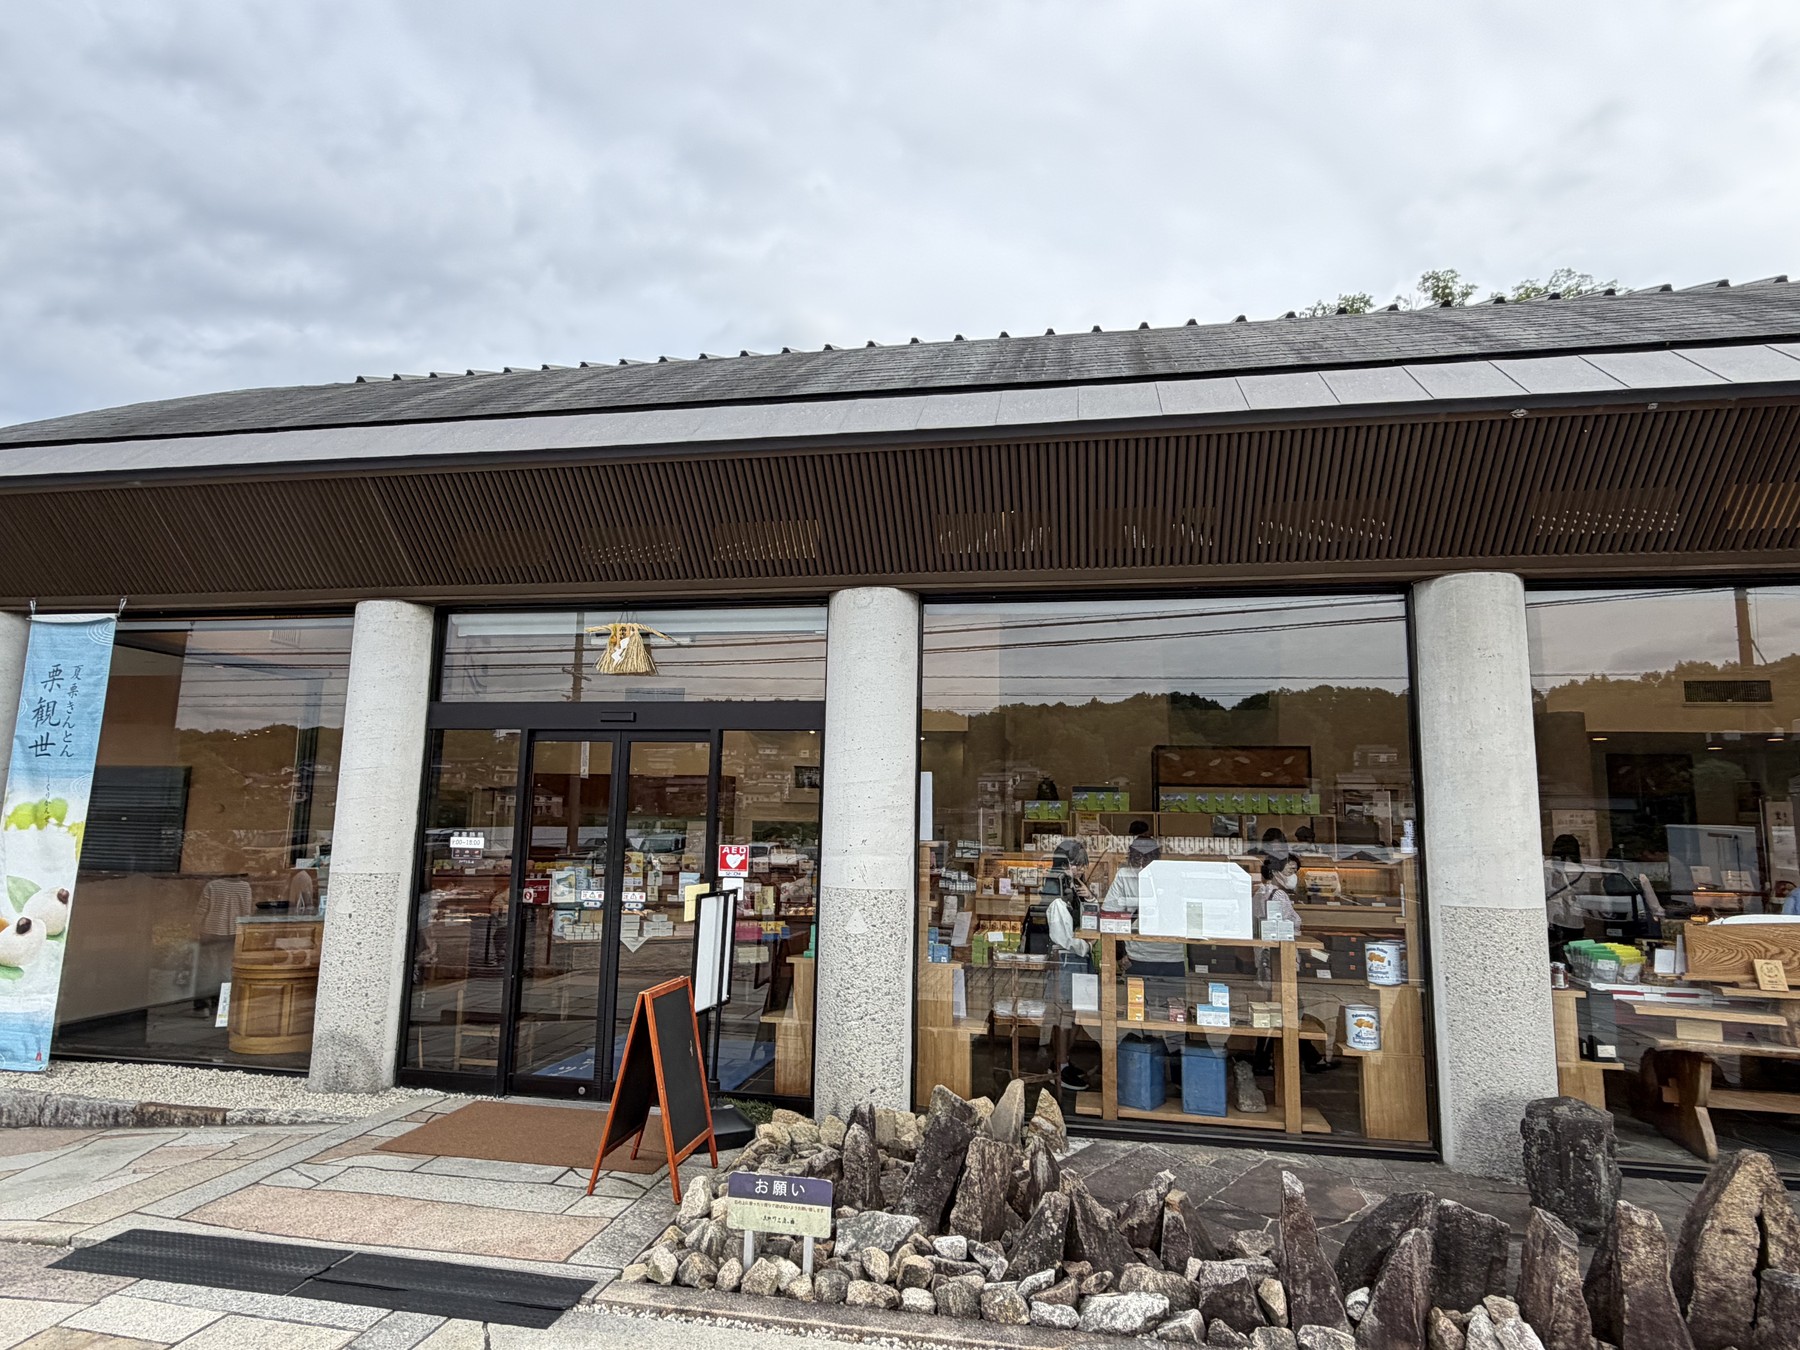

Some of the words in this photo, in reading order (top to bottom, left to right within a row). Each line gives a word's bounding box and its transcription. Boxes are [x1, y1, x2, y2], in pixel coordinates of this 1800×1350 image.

[28, 663, 64, 758] 栗観世
[722, 846, 747, 854] AED
[754, 1178, 806, 1197] お願い
